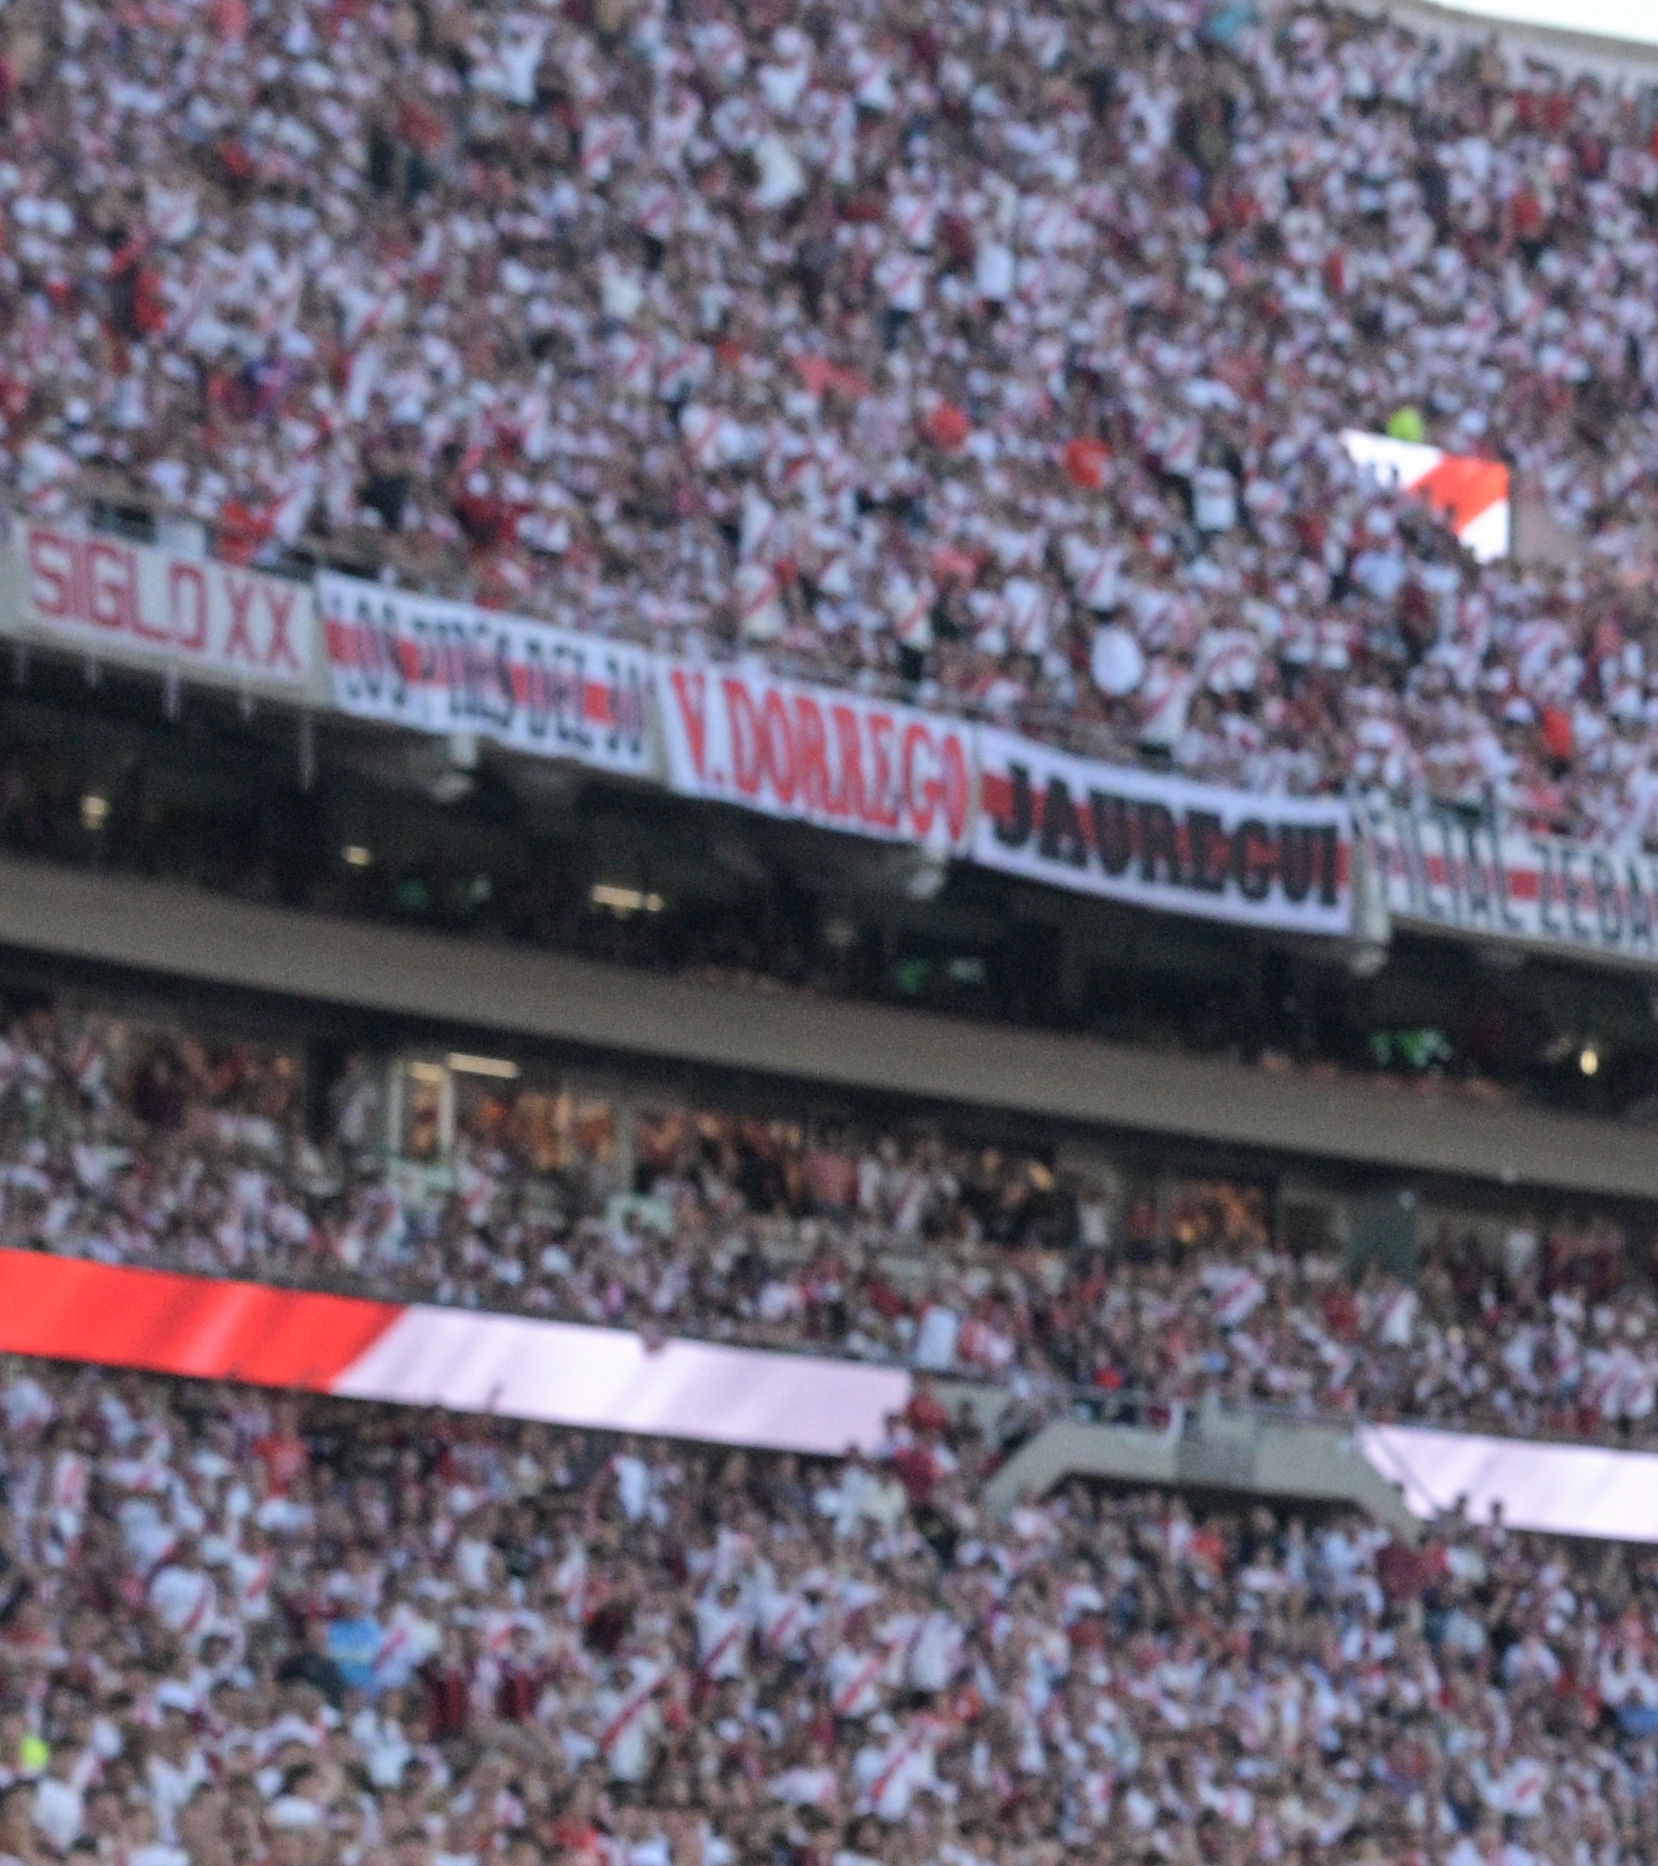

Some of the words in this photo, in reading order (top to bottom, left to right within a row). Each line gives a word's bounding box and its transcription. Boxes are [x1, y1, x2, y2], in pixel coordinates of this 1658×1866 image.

[28, 530, 209, 650] SIGLO
[223, 574, 310, 674] XX
[723, 676, 968, 844] DORREGO
